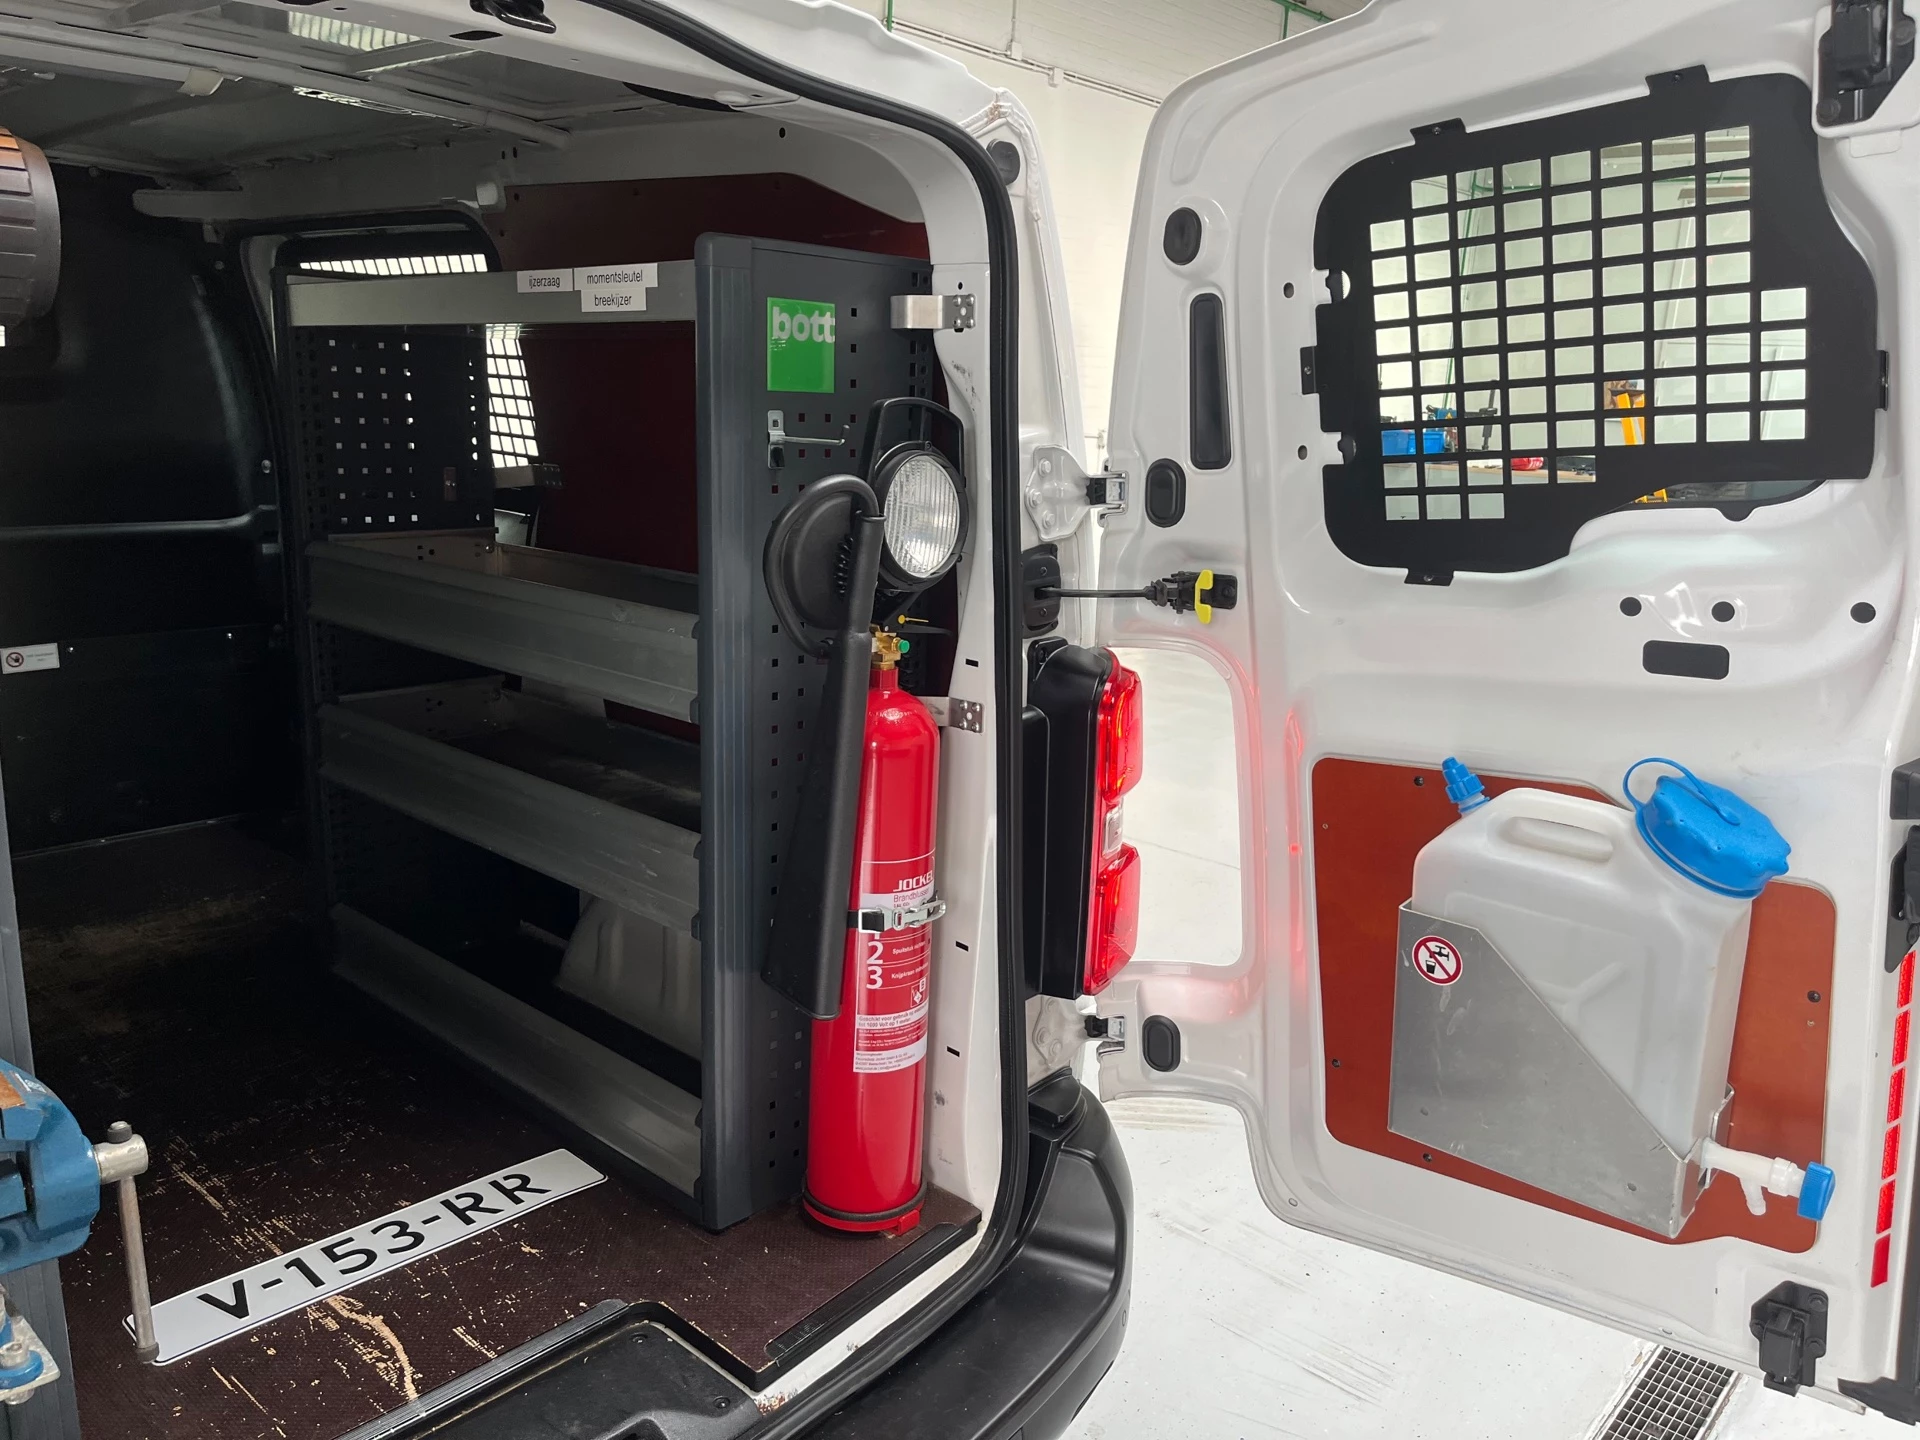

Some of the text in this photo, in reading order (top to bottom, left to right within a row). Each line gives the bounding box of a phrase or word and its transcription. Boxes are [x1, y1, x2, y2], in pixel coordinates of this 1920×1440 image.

[529, 276, 560, 289] ijzerzaag
[587, 269, 643, 285] momentsleutel
[594, 293, 632, 308] breekijzer
[773, 306, 835, 343] bott
[867, 941, 884, 964] 2
[866, 965, 883, 989] 3
[197, 1173, 552, 1320] V-153-RR
